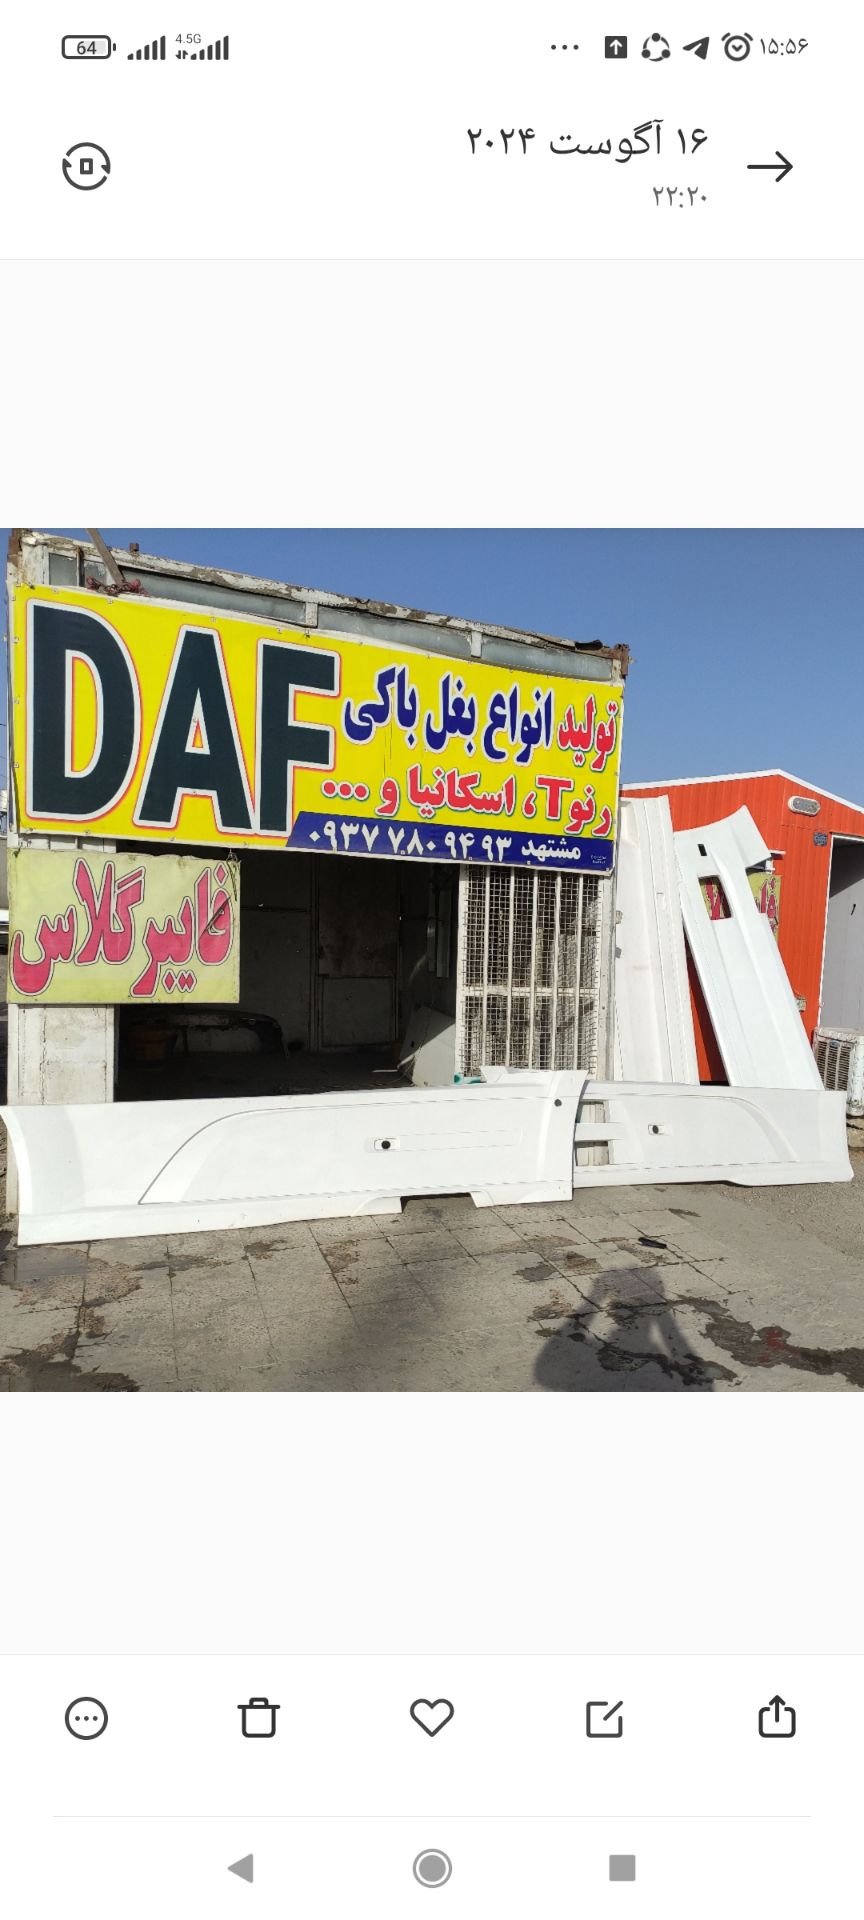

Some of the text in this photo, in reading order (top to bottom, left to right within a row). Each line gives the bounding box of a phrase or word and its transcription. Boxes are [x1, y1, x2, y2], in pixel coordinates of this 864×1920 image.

[29, 602, 338, 834] DAF
[344, 666, 617, 770] تولید انواع بغل باکی
[377, 777, 401, 815] و
[407, 766, 515, 817] اسکانیا
[308, 820, 380, 853] ۰۹۳۷
[387, 825, 438, 856] ۷۸۰
[481, 834, 512, 863] ۹۳
[10, 858, 235, 998] فایبرگلاس
